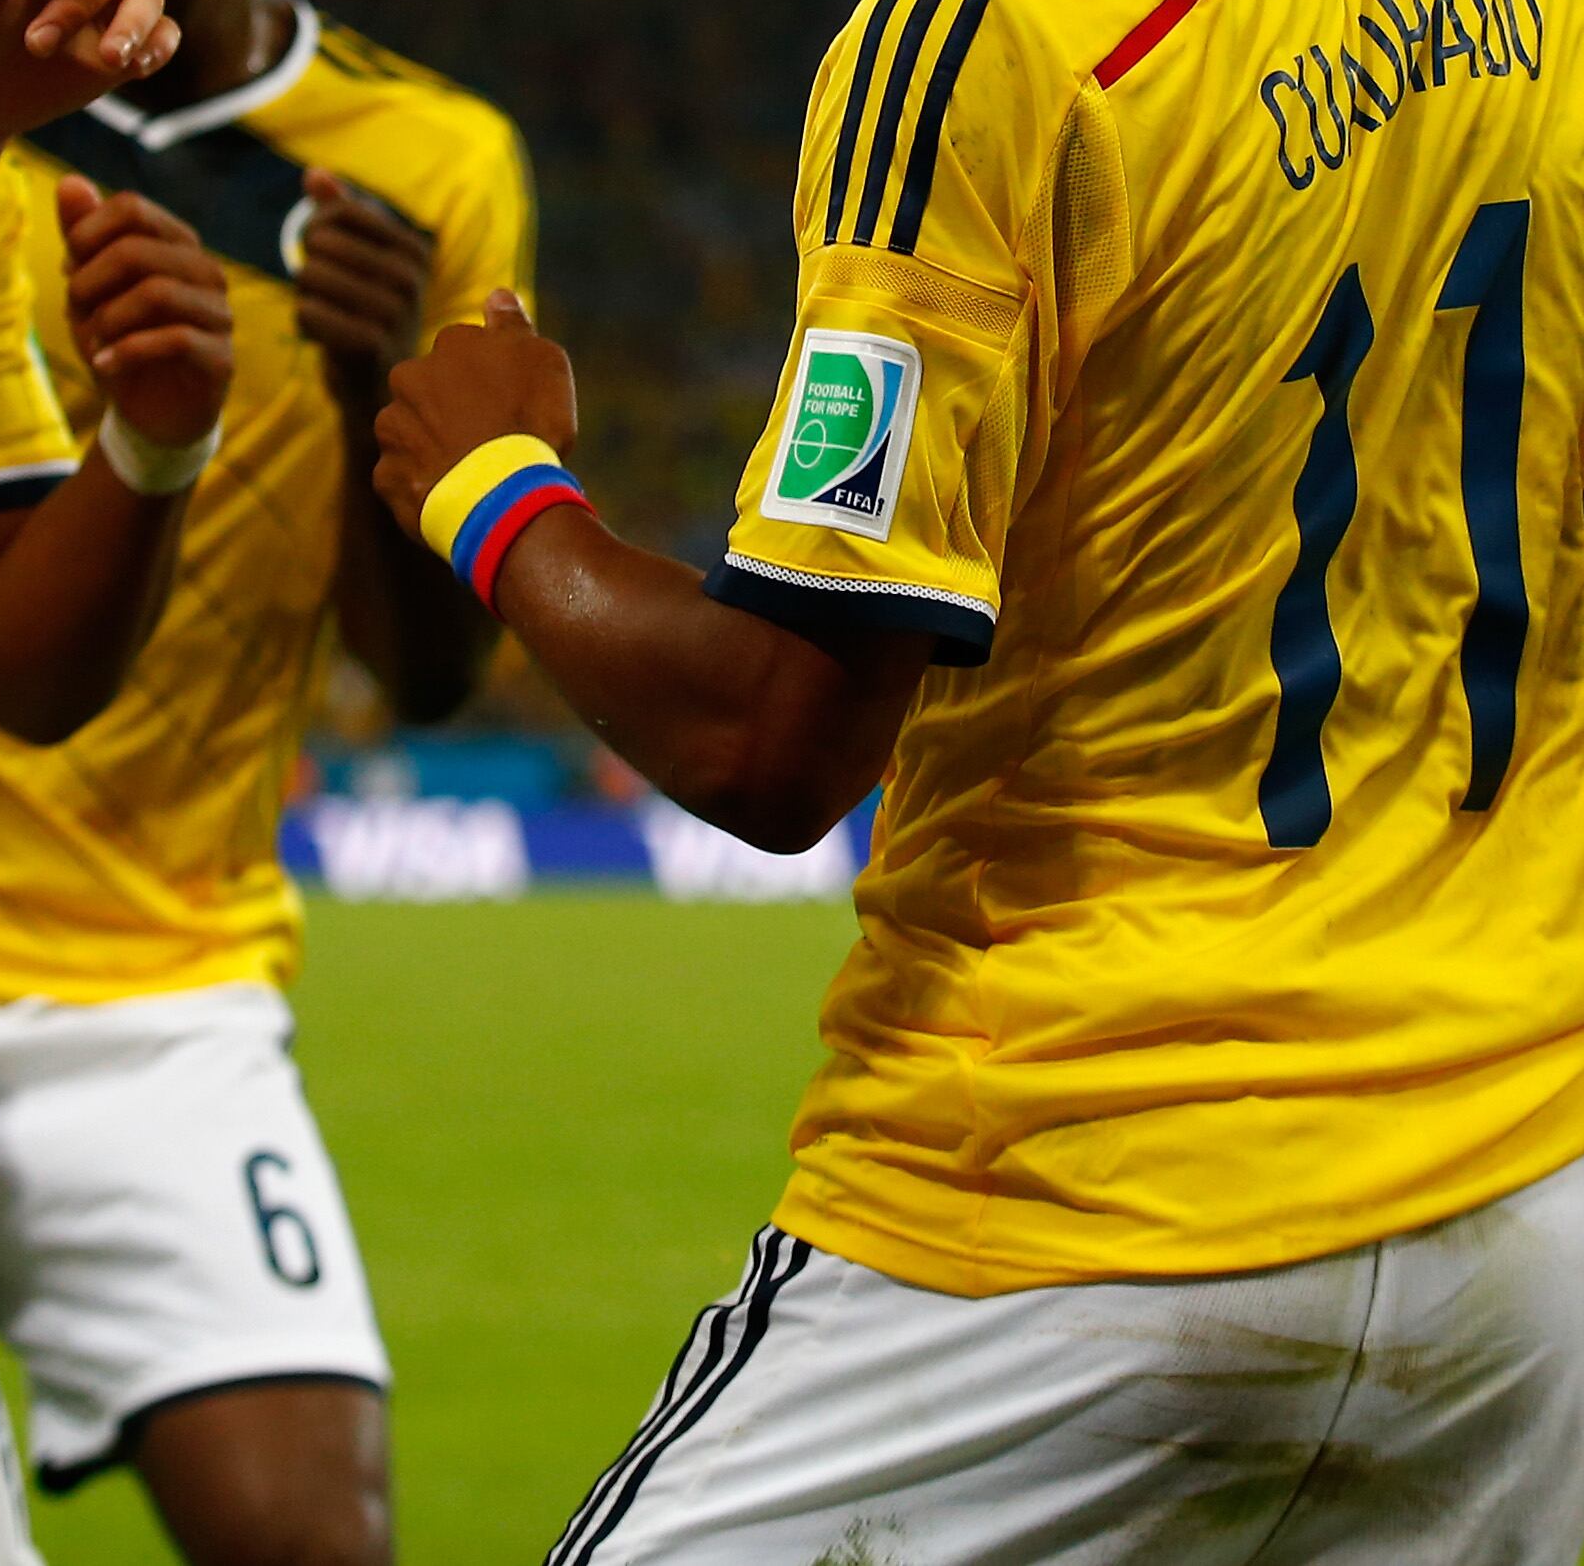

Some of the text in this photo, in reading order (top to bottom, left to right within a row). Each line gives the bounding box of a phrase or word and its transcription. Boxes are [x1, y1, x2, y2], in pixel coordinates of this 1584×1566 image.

[807, 382, 866, 402] FOOTBALL
[804, 400, 860, 418] FOR HOPE
[834, 488, 872, 510] FIFA
[1258, 199, 1530, 848] 11
[243, 1149, 322, 1289] 6
